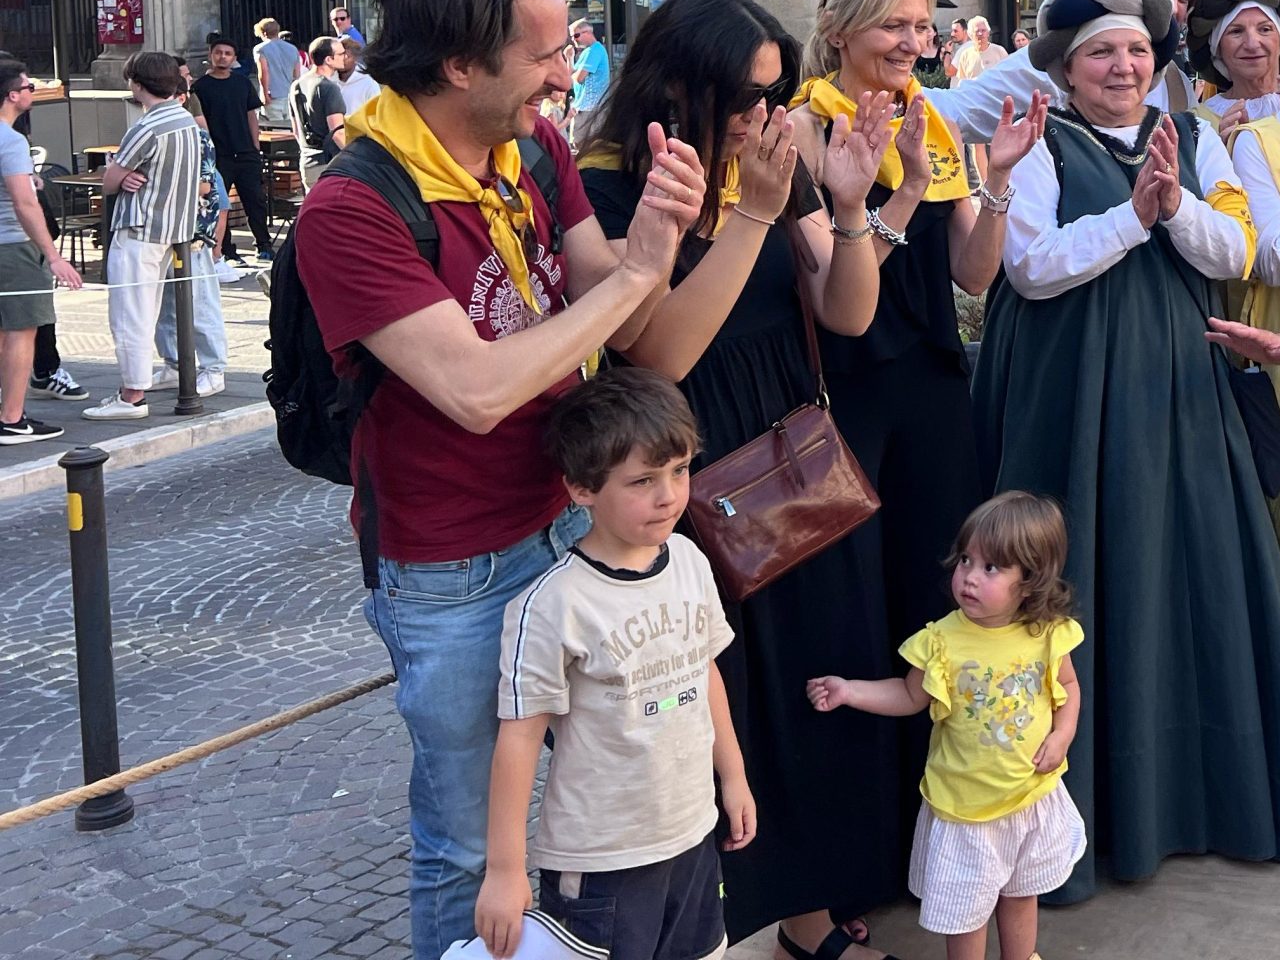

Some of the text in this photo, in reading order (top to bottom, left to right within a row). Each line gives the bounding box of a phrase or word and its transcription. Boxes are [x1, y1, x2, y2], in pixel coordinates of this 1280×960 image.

[631, 659, 669, 685] activity
[671, 653, 685, 672] for
[687, 647, 698, 665] all
